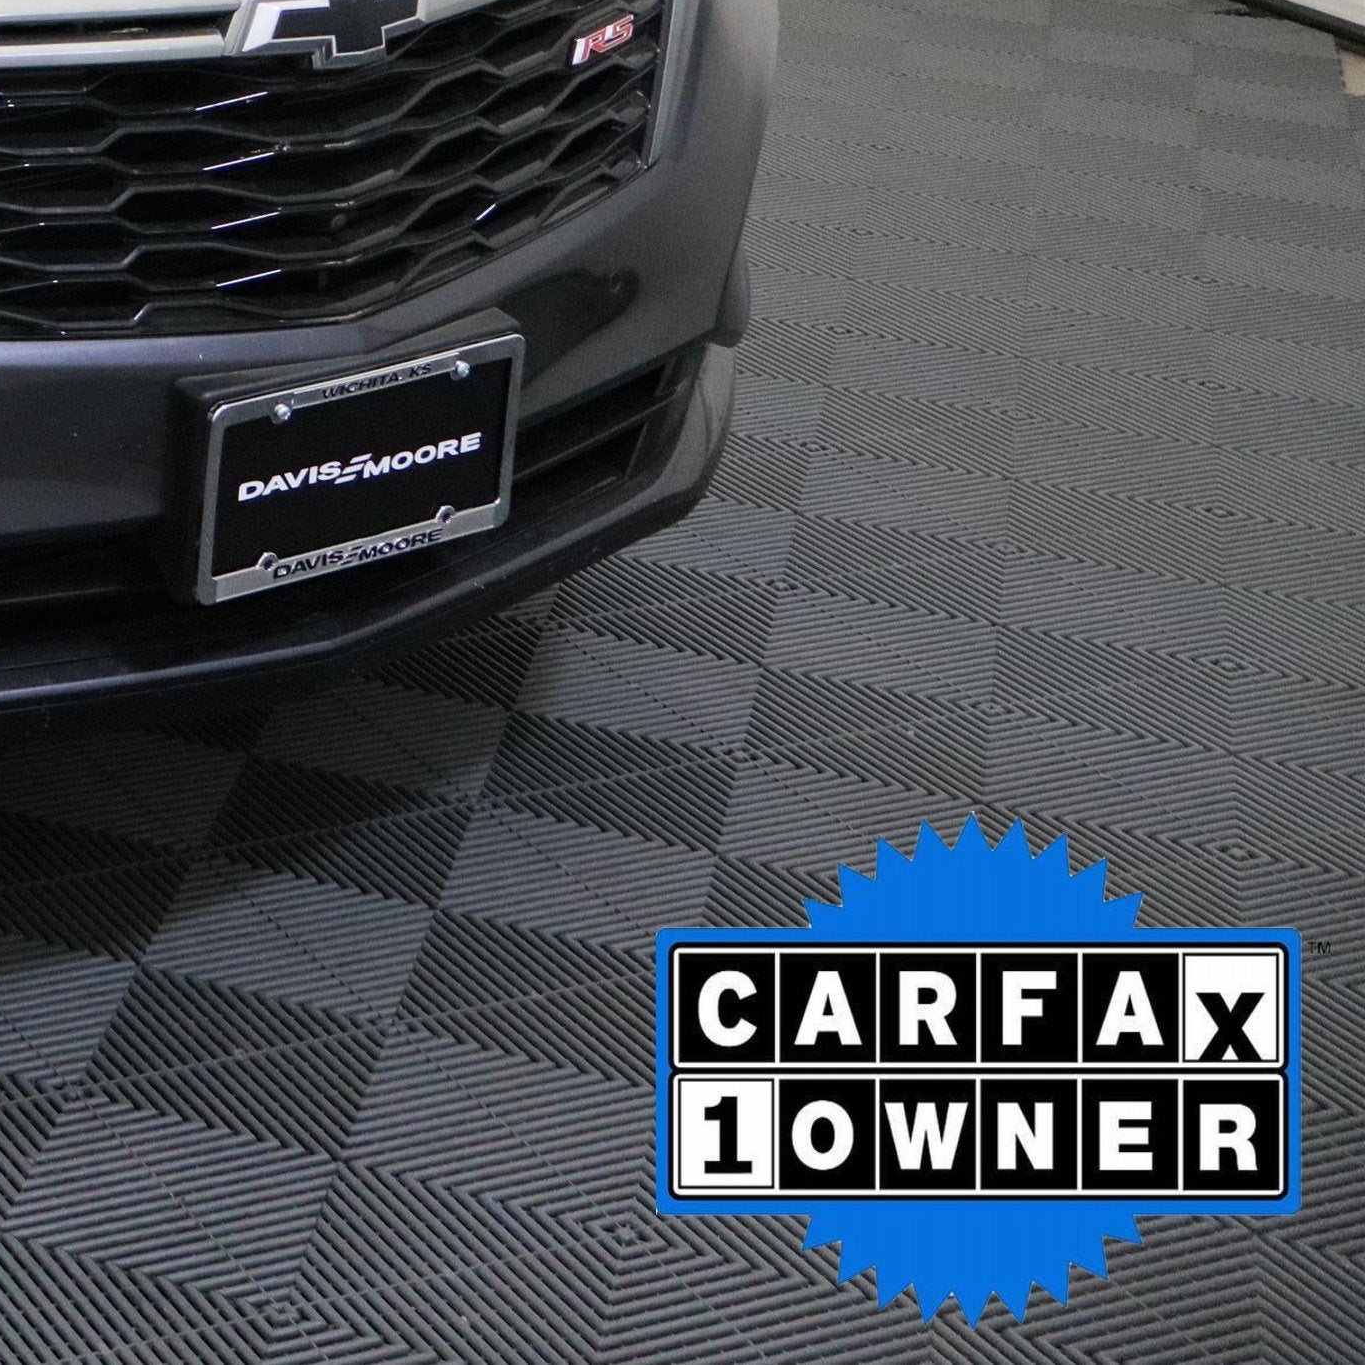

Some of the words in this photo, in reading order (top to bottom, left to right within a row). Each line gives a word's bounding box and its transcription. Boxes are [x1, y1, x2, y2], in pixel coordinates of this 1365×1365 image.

[571, 14, 635, 66] RS
[409, 362, 432, 378] KS
[237, 460, 343, 502] DAVIS
[362, 431, 482, 479] MOORE
[273, 550, 345, 579] DAVIS
[358, 528, 444, 562] MOORE
